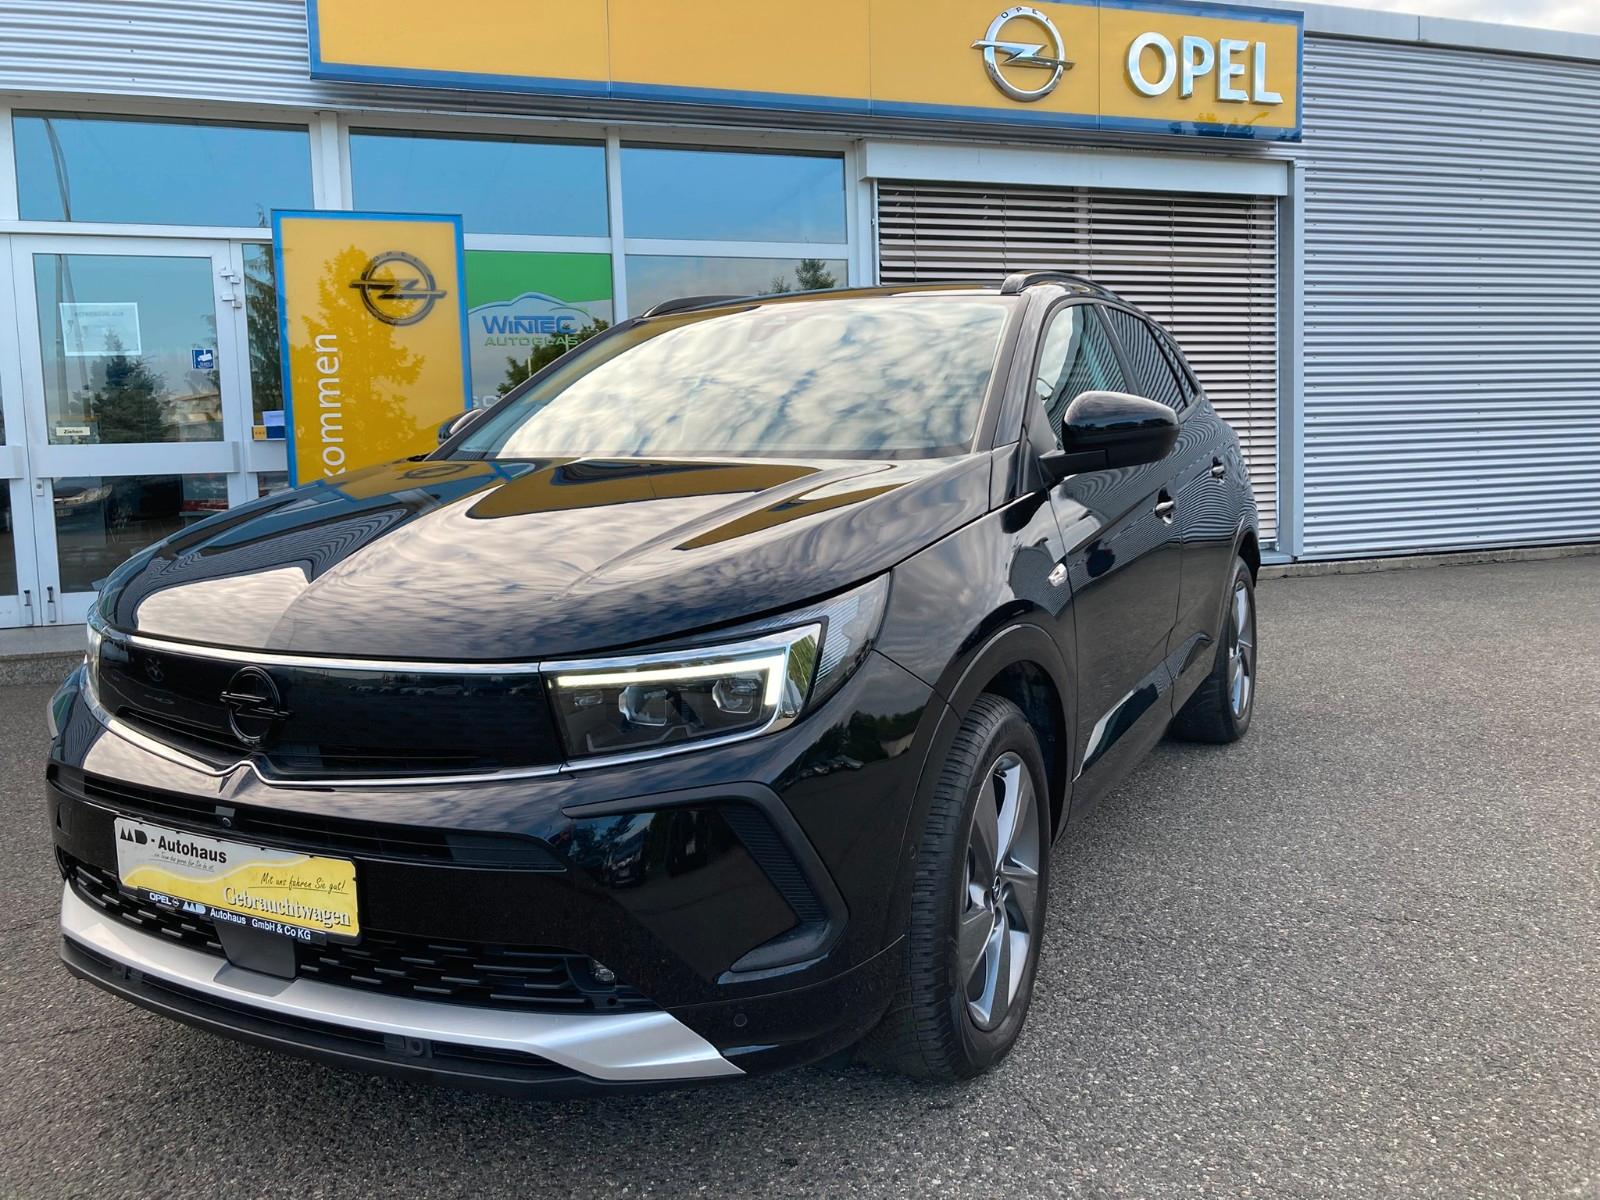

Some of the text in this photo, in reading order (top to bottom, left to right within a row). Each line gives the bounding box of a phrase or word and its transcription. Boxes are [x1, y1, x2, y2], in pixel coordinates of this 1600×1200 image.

[1126, 31, 1283, 104] OPEL
[485, 336, 578, 346] AUTOGLAS
[157, 835, 227, 864] Autohaus
[260, 872, 274, 885] Mit
[276, 878, 287, 886] uns
[288, 875, 312, 891] fahren
[314, 876, 327, 890] Sie
[149, 892, 172, 905] OPEL
[209, 908, 247, 925] Autohaus
[251, 918, 276, 932] GmbH
[276, 923, 283, 934] &
[284, 925, 297, 937] Co
[297, 929, 311, 940] KG
[224, 886, 351, 928] Gebrauchtwagen
